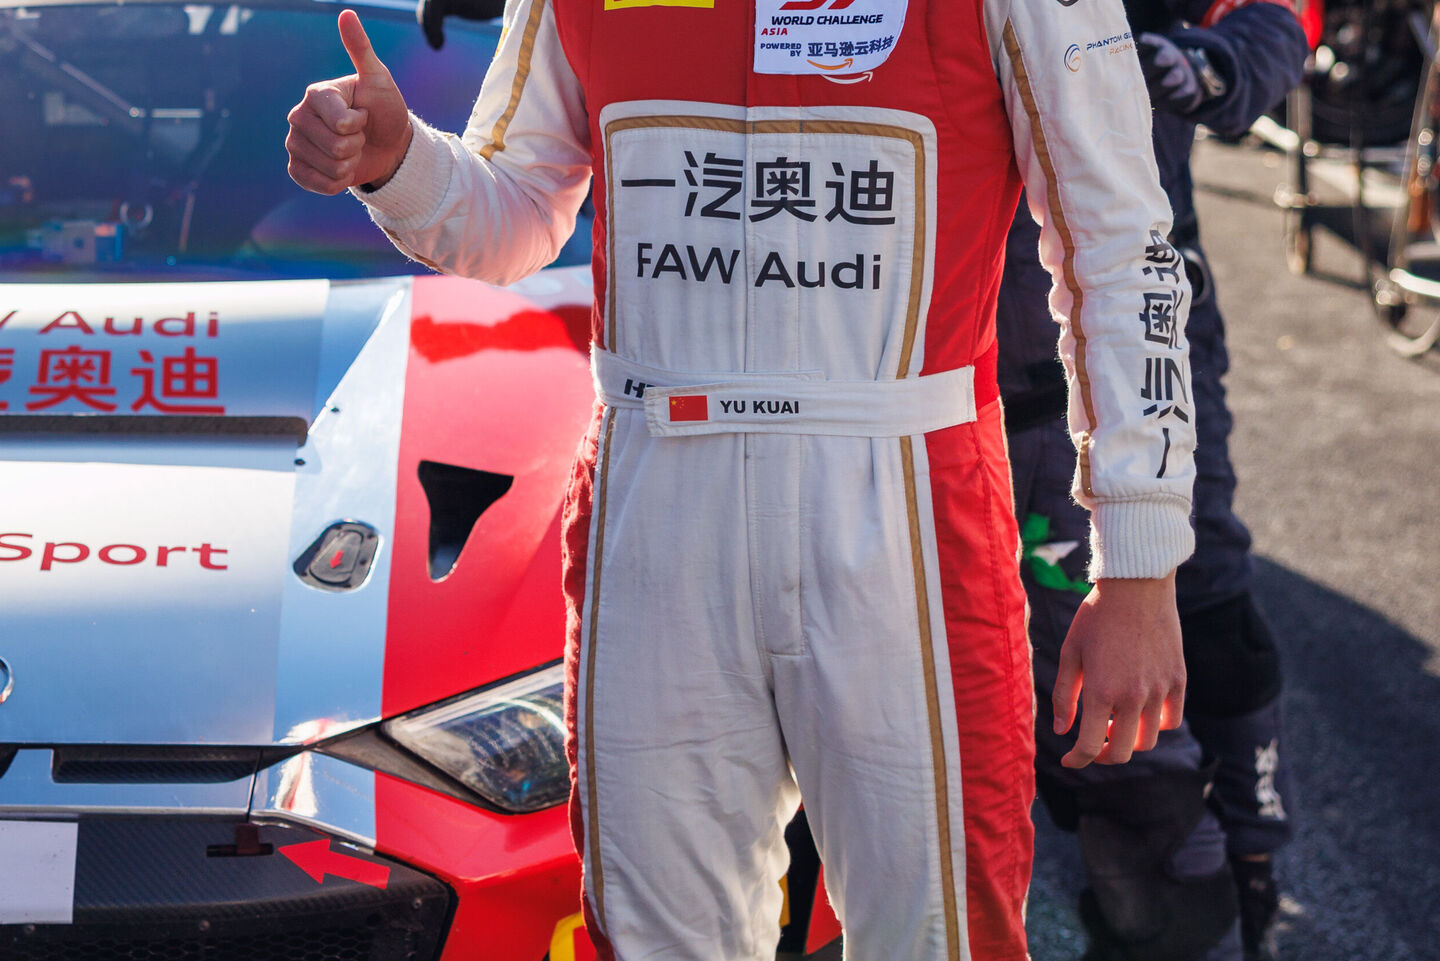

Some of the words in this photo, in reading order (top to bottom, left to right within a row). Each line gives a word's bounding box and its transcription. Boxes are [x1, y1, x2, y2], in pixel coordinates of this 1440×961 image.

[771, 15, 814, 26] WORLD
[816, 14, 883, 25] CHALLENGE
[761, 27, 788, 36] ASIA
[1086, 35, 1122, 51] PHANTOM
[621, 150, 895, 225] 一汽奥迪
[637, 242, 740, 284] FAW
[754, 251, 881, 290] Audi
[38, 310, 220, 338] Audi
[720, 400, 746, 414] YU
[753, 400, 799, 414] KUAI
